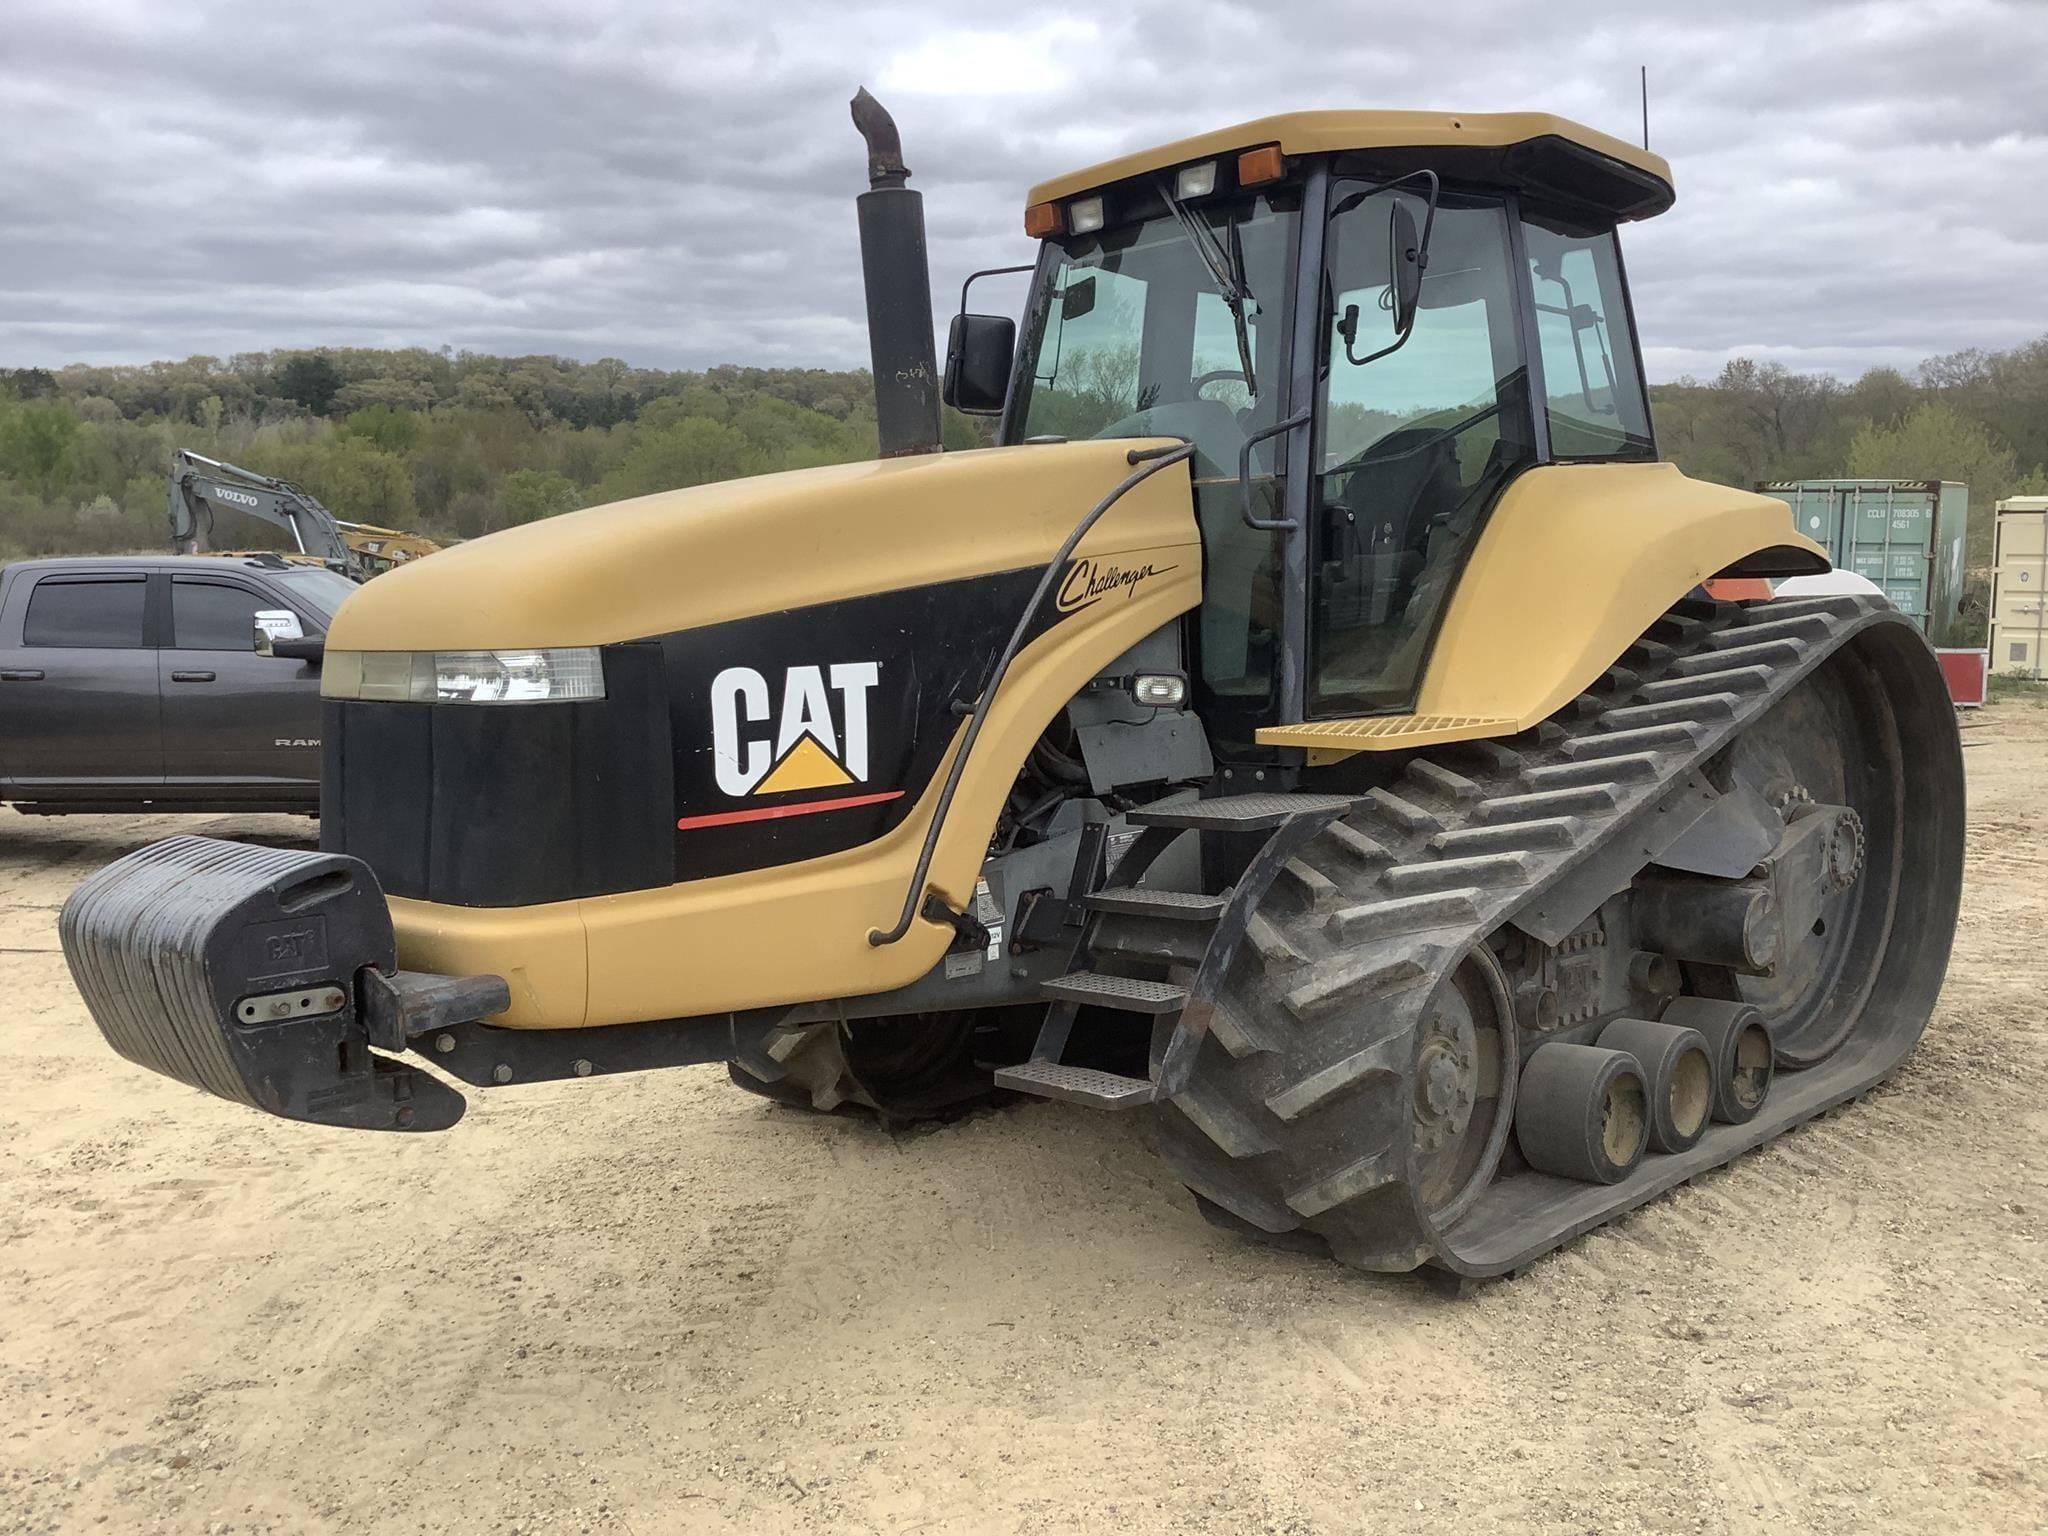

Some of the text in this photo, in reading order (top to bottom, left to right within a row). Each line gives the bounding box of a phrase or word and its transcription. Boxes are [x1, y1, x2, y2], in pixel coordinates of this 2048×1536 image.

[214, 487, 258, 507] VOLVO
[1058, 559, 1179, 608] Challenger
[710, 661, 879, 797] CAT
